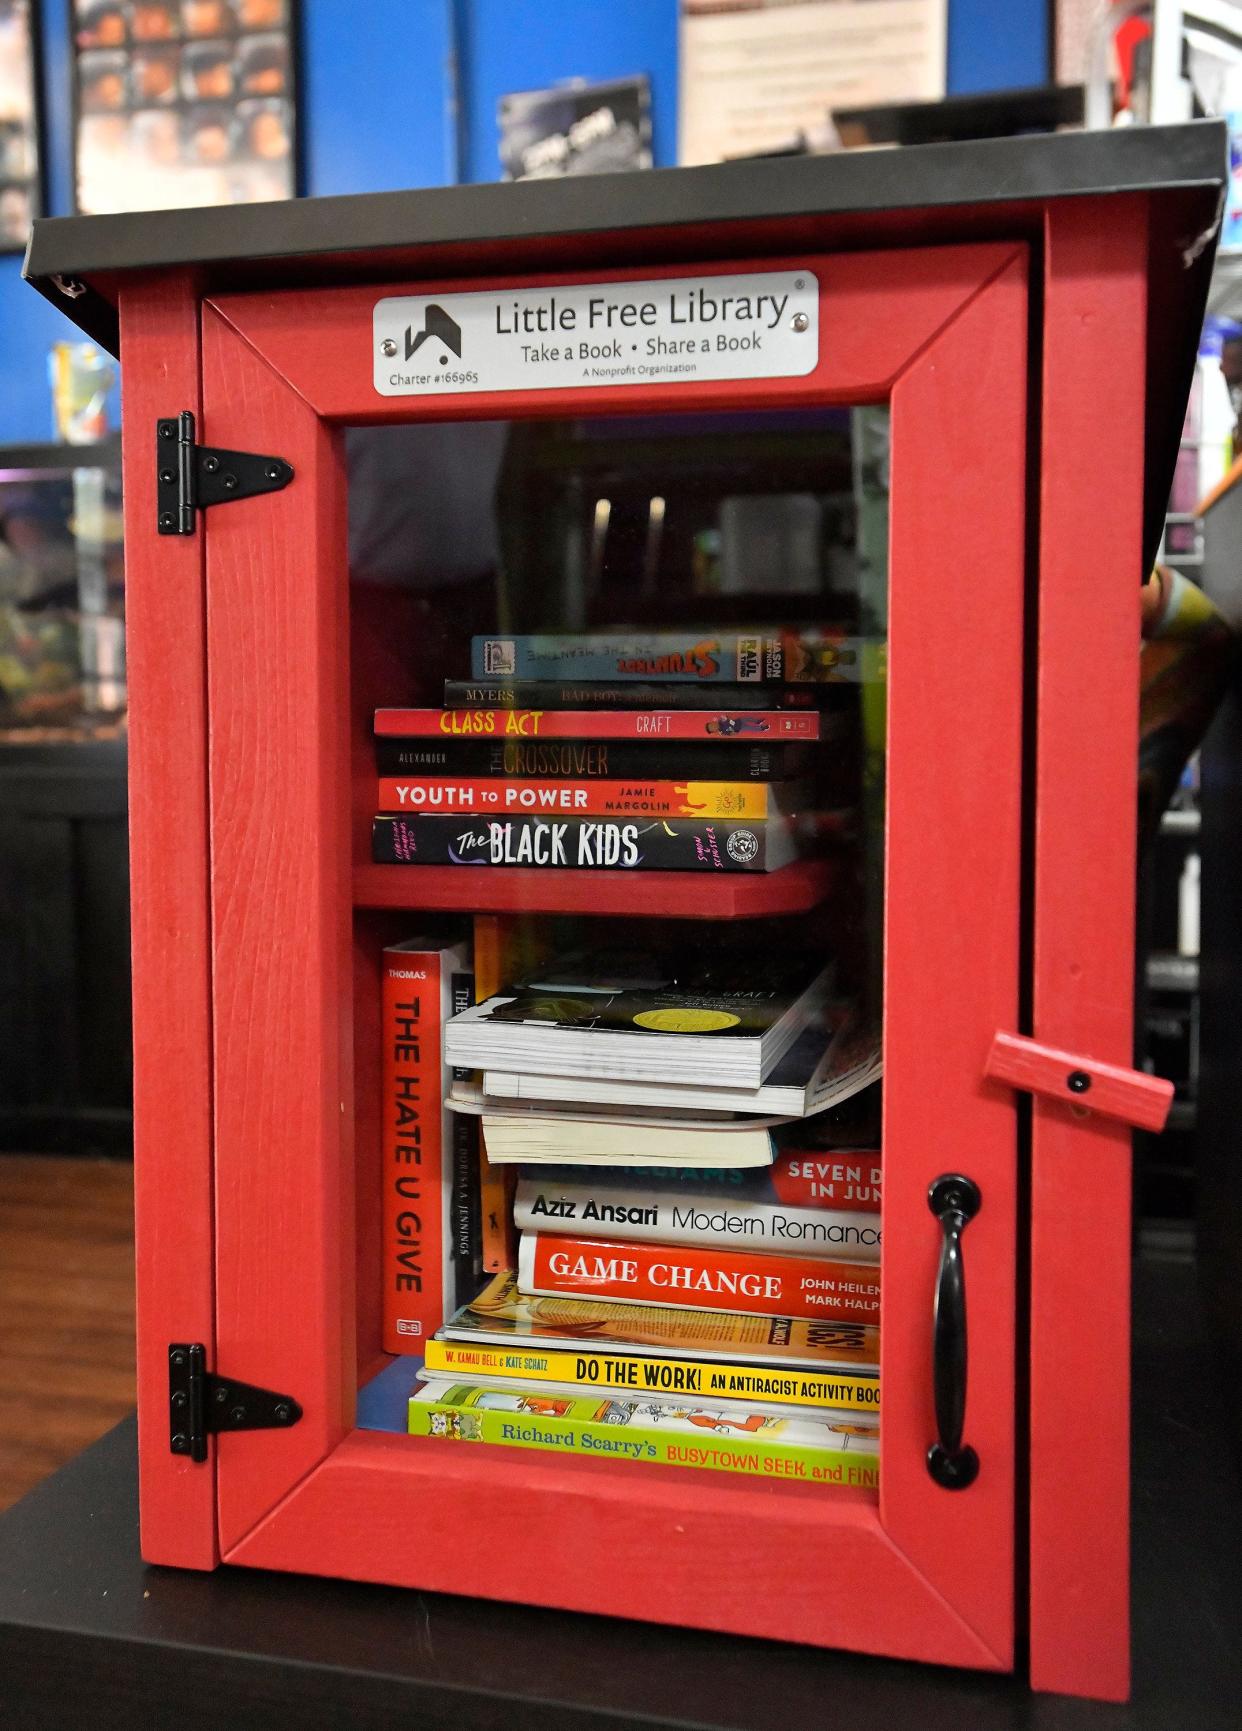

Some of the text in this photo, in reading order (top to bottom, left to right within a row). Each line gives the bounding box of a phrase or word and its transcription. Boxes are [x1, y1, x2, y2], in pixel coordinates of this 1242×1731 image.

[496, 287, 789, 334] Little Free Library
[520, 330, 762, 363] Take a Book Share a Book
[389, 371, 478, 386] Charter #166965
[582, 363, 697, 378] A Nonprofit Organization
[772, 640, 782, 678] JASON
[466, 689, 515, 701] MYERS
[439, 711, 544, 736] CLASS ACT
[636, 716, 672, 733] CRAFT
[399, 752, 446, 764] ALEXANDER
[503, 745, 609, 775] CROSSOVER
[396, 786, 473, 805] YOUTH
[505, 788, 588, 808] POWER
[619, 788, 656, 797] JAMIE
[605, 801, 670, 811] MARGOLIN
[456, 822, 640, 867] The BLACK KIDS
[388, 969, 427, 980] THOMAS
[455, 987, 470, 1013] THE
[394, 997, 423, 1294] THE HATE U GIVE
[787, 1161, 882, 1185] SEVEN D
[811, 1182, 882, 1203] IN JUN
[530, 1194, 659, 1226] Aziz Ansari
[672, 1205, 764, 1236] Modern
[457, 1205, 470, 1255] JENNINGS
[548, 1251, 783, 1301] GAME CHANGE
[800, 1277, 835, 1291] JOHN
[805, 1294, 881, 1311] MARK HALP
[445, 1350, 456, 1363] W.
[457, 1351, 480, 1365] KAMAU
[481, 1353, 498, 1367] BELL
[505, 1355, 522, 1369] KATE
[524, 1357, 548, 1371] SCHATZ
[576, 1358, 701, 1391] DO THE WORK!
[710, 1373, 880, 1404] AN ANTIRACIST ACTIVITY BOO
[501, 1424, 657, 1458] Richard Scarry's
[763, 1457, 807, 1477] SEEK
[811, 1464, 843, 1481] and
